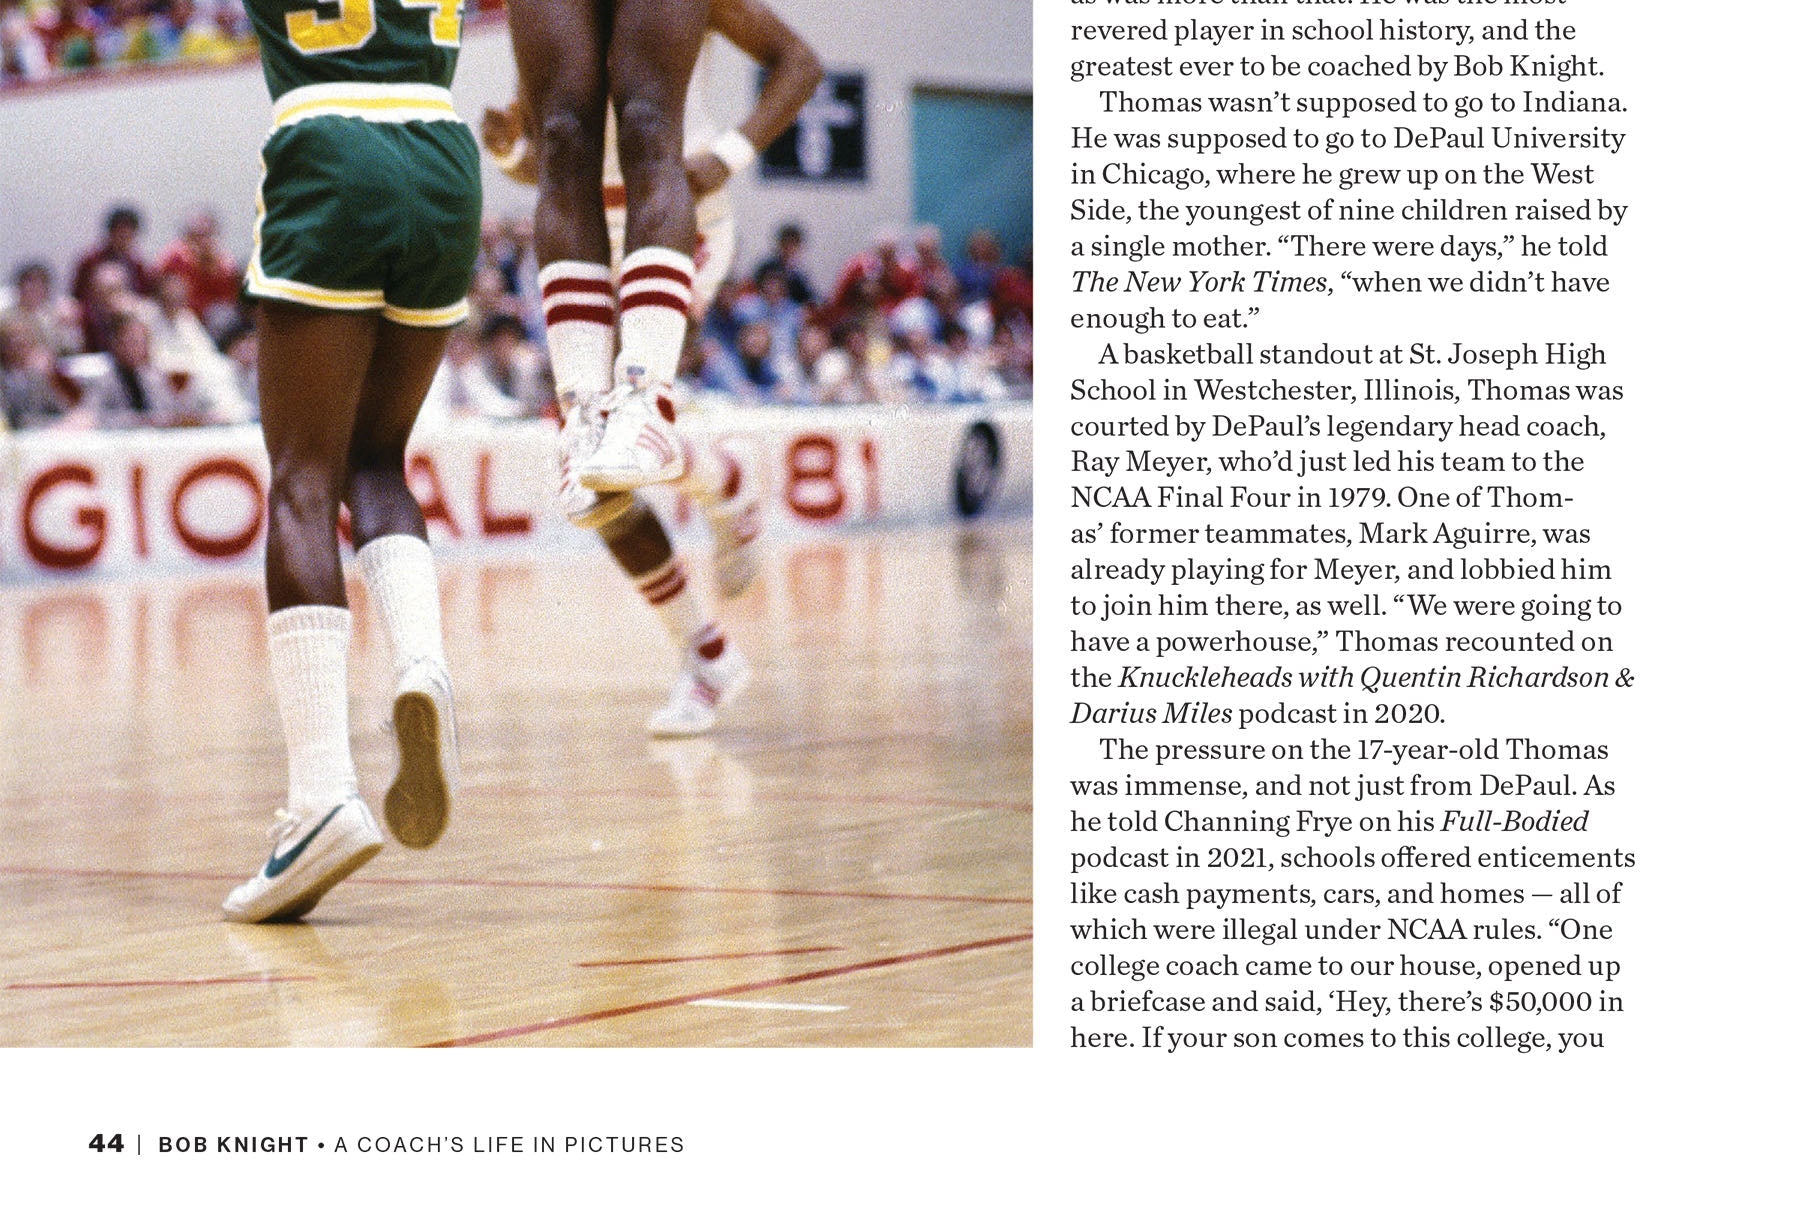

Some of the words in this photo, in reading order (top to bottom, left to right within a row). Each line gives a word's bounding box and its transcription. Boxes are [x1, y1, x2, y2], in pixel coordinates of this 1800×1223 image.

[1070, 56, 1173, 83] greatest
[1179, 61, 1235, 77] ever
[1239, 56, 1265, 77] to
[1270, 54, 1301, 77] be
[1307, 54, 1412, 77] coached
[1416, 54, 1449, 83] by
[1453, 54, 1503, 77] Bob
[1509, 54, 1604, 83] Knight.
[1071, 162, 1096, 185] in
[1102, 162, 1211, 191] Chicago,
[1215, 162, 1296, 185] where
[1301, 162, 1333, 185] he
[1338, 167, 1402, 191] grew
[1406, 169, 1439, 191] up
[1444, 169, 1477, 185] on
[1483, 162, 1525, 185] the
[1530, 162, 1595, 185] West
[1097, 342, 1120, 365] A
[1122, 342, 1254, 365] basketball
[1259, 342, 1374, 365] standout
[1379, 344, 1404, 365] at
[1409, 342, 1441, 365] St.
[1447, 342, 1538, 371] Joseph
[1545, 342, 1607, 371] High
[1071, 485, 1153, 508] NCAA
[1157, 485, 1224, 508] Final
[1230, 485, 1292, 508] Four
[1297, 485, 1322, 508] in
[1328, 487, 1391, 508] 1979.
[1397, 485, 1450, 508] One
[1456, 485, 1484, 508] of
[1487, 485, 1574, 508] Thom-
[22, 456, 532, 569] GIOAL
[1071, 557, 1166, 586] already
[1171, 557, 1265, 586] playing
[1269, 557, 1308, 580] for
[1313, 557, 1400, 586] Meyer,
[1407, 557, 1455, 580] and
[1460, 557, 1556, 580] lobbied
[1560, 557, 1612, 580] him
[1070, 665, 1112, 688] the
[1117, 665, 1293, 688] Knuckleheads
[1298, 665, 1354, 688] with
[1360, 665, 1462, 694] Quentin
[1466, 665, 1609, 688] Richardson
[1614, 667, 1635, 688] &
[1068, 701, 1158, 724] Darius
[1161, 701, 1233, 724] Miles
[1238, 701, 1338, 730] podcast
[1343, 701, 1369, 724] in
[1374, 703, 1445, 724] 2020.
[1070, 809, 1102, 832] he
[1107, 809, 1159, 832] told
[1164, 809, 1291, 838] Channing
[1296, 810, 1353, 838] Frye
[1359, 816, 1392, 832] on
[1397, 809, 1435, 832] his
[1439, 809, 1590, 832] Full-Bodied
[1070, 845, 1170, 874] podcast
[1176, 845, 1201, 868] in
[1207, 847, 1274, 872] 2021,
[1280, 845, 1376, 868] schools
[1381, 845, 1472, 868] offered
[1477, 845, 1636, 868] enticements
[1070, 953, 1160, 982] college
[1166, 953, 1240, 976] coach
[1245, 960, 1312, 976] came
[1317, 955, 1343, 976] to
[1350, 960, 1395, 976] our
[1399, 953, 1482, 980] house,
[1488, 953, 1582, 982] opened
[1588, 960, 1621, 982] up
[88, 1133, 125, 1153] 44
[159, 1136, 207, 1153] BOB
[217, 1136, 308, 1153] KNIGHT
[334, 1136, 348, 1153] A
[357, 1136, 464, 1153] COACH’S
[474, 1136, 524, 1153] LIFE
[534, 1136, 555, 1153] IN
[565, 1136, 684, 1153] PICTURES
